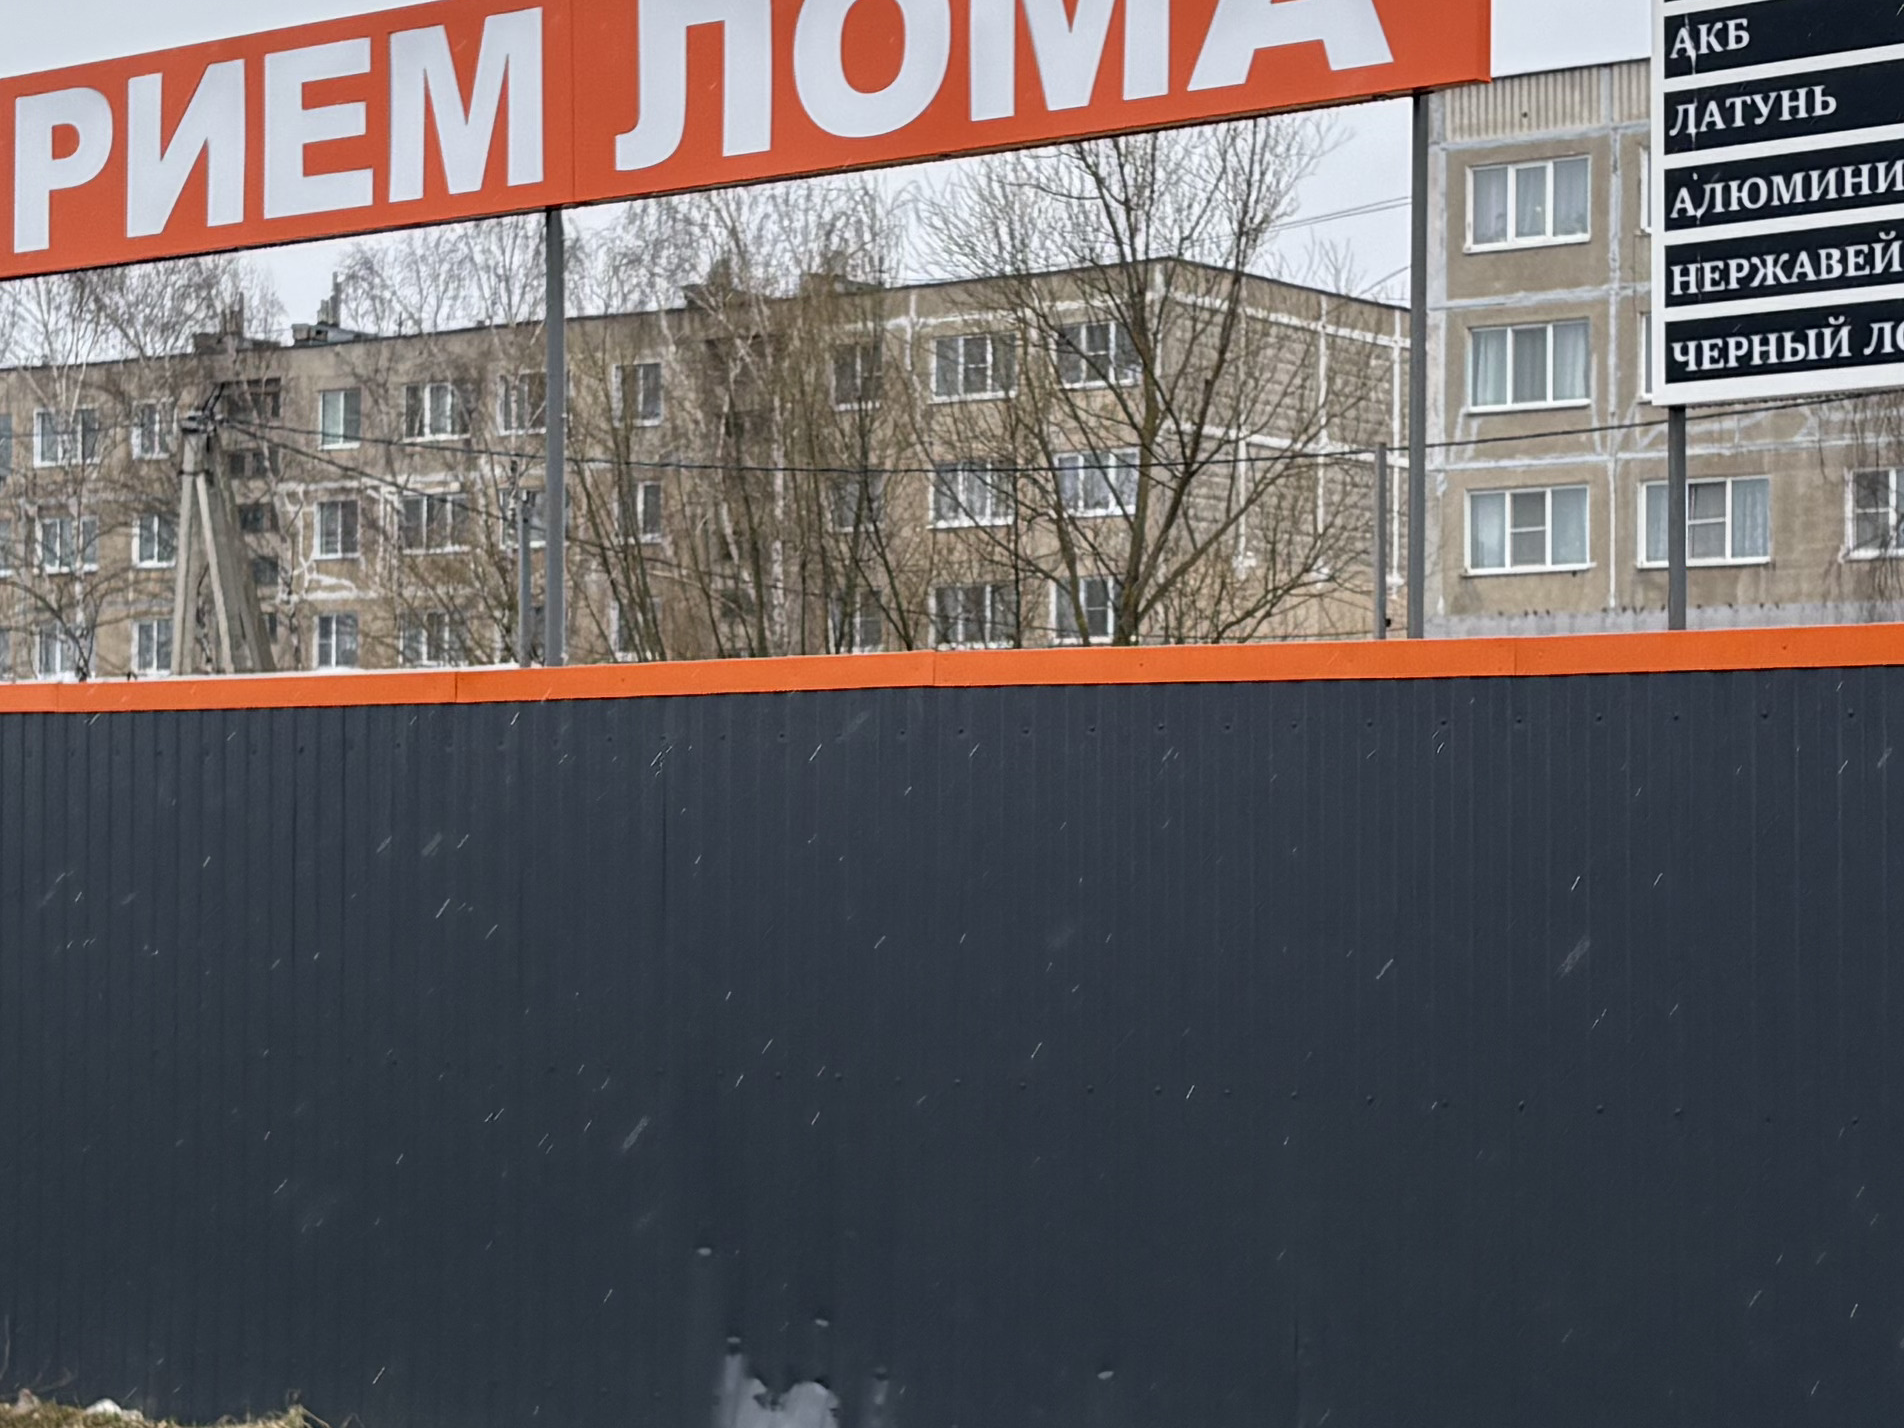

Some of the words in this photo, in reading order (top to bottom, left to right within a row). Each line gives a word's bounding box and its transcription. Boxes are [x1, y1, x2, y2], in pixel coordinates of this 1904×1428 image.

[1669, 18, 1750, 60] АКБ
[1669, 85, 1837, 137] ЛАТУНЬ
[1671, 315, 1851, 371] ЧЕРНЫЙ
